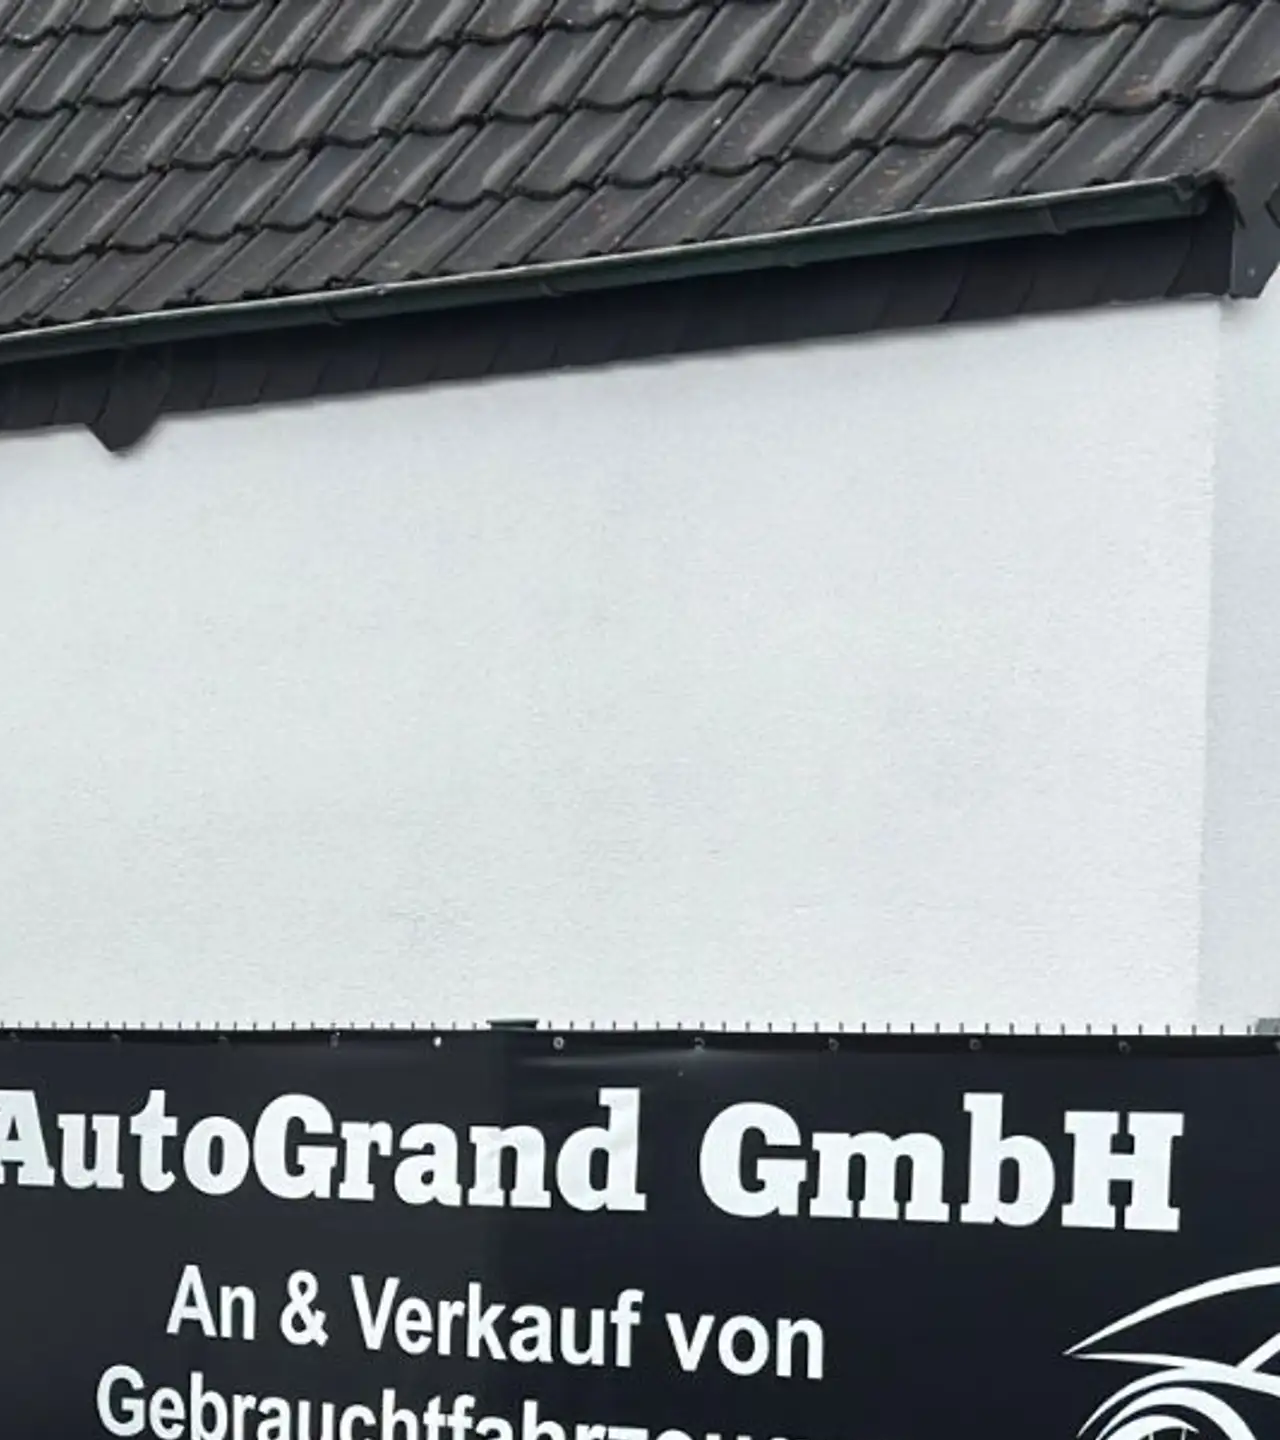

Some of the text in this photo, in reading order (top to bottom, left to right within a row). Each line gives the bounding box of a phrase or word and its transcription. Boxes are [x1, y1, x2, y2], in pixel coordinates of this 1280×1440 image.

[699, 1092, 1185, 1232] GmbH
[166, 1264, 824, 1380] An & Verkauf von
